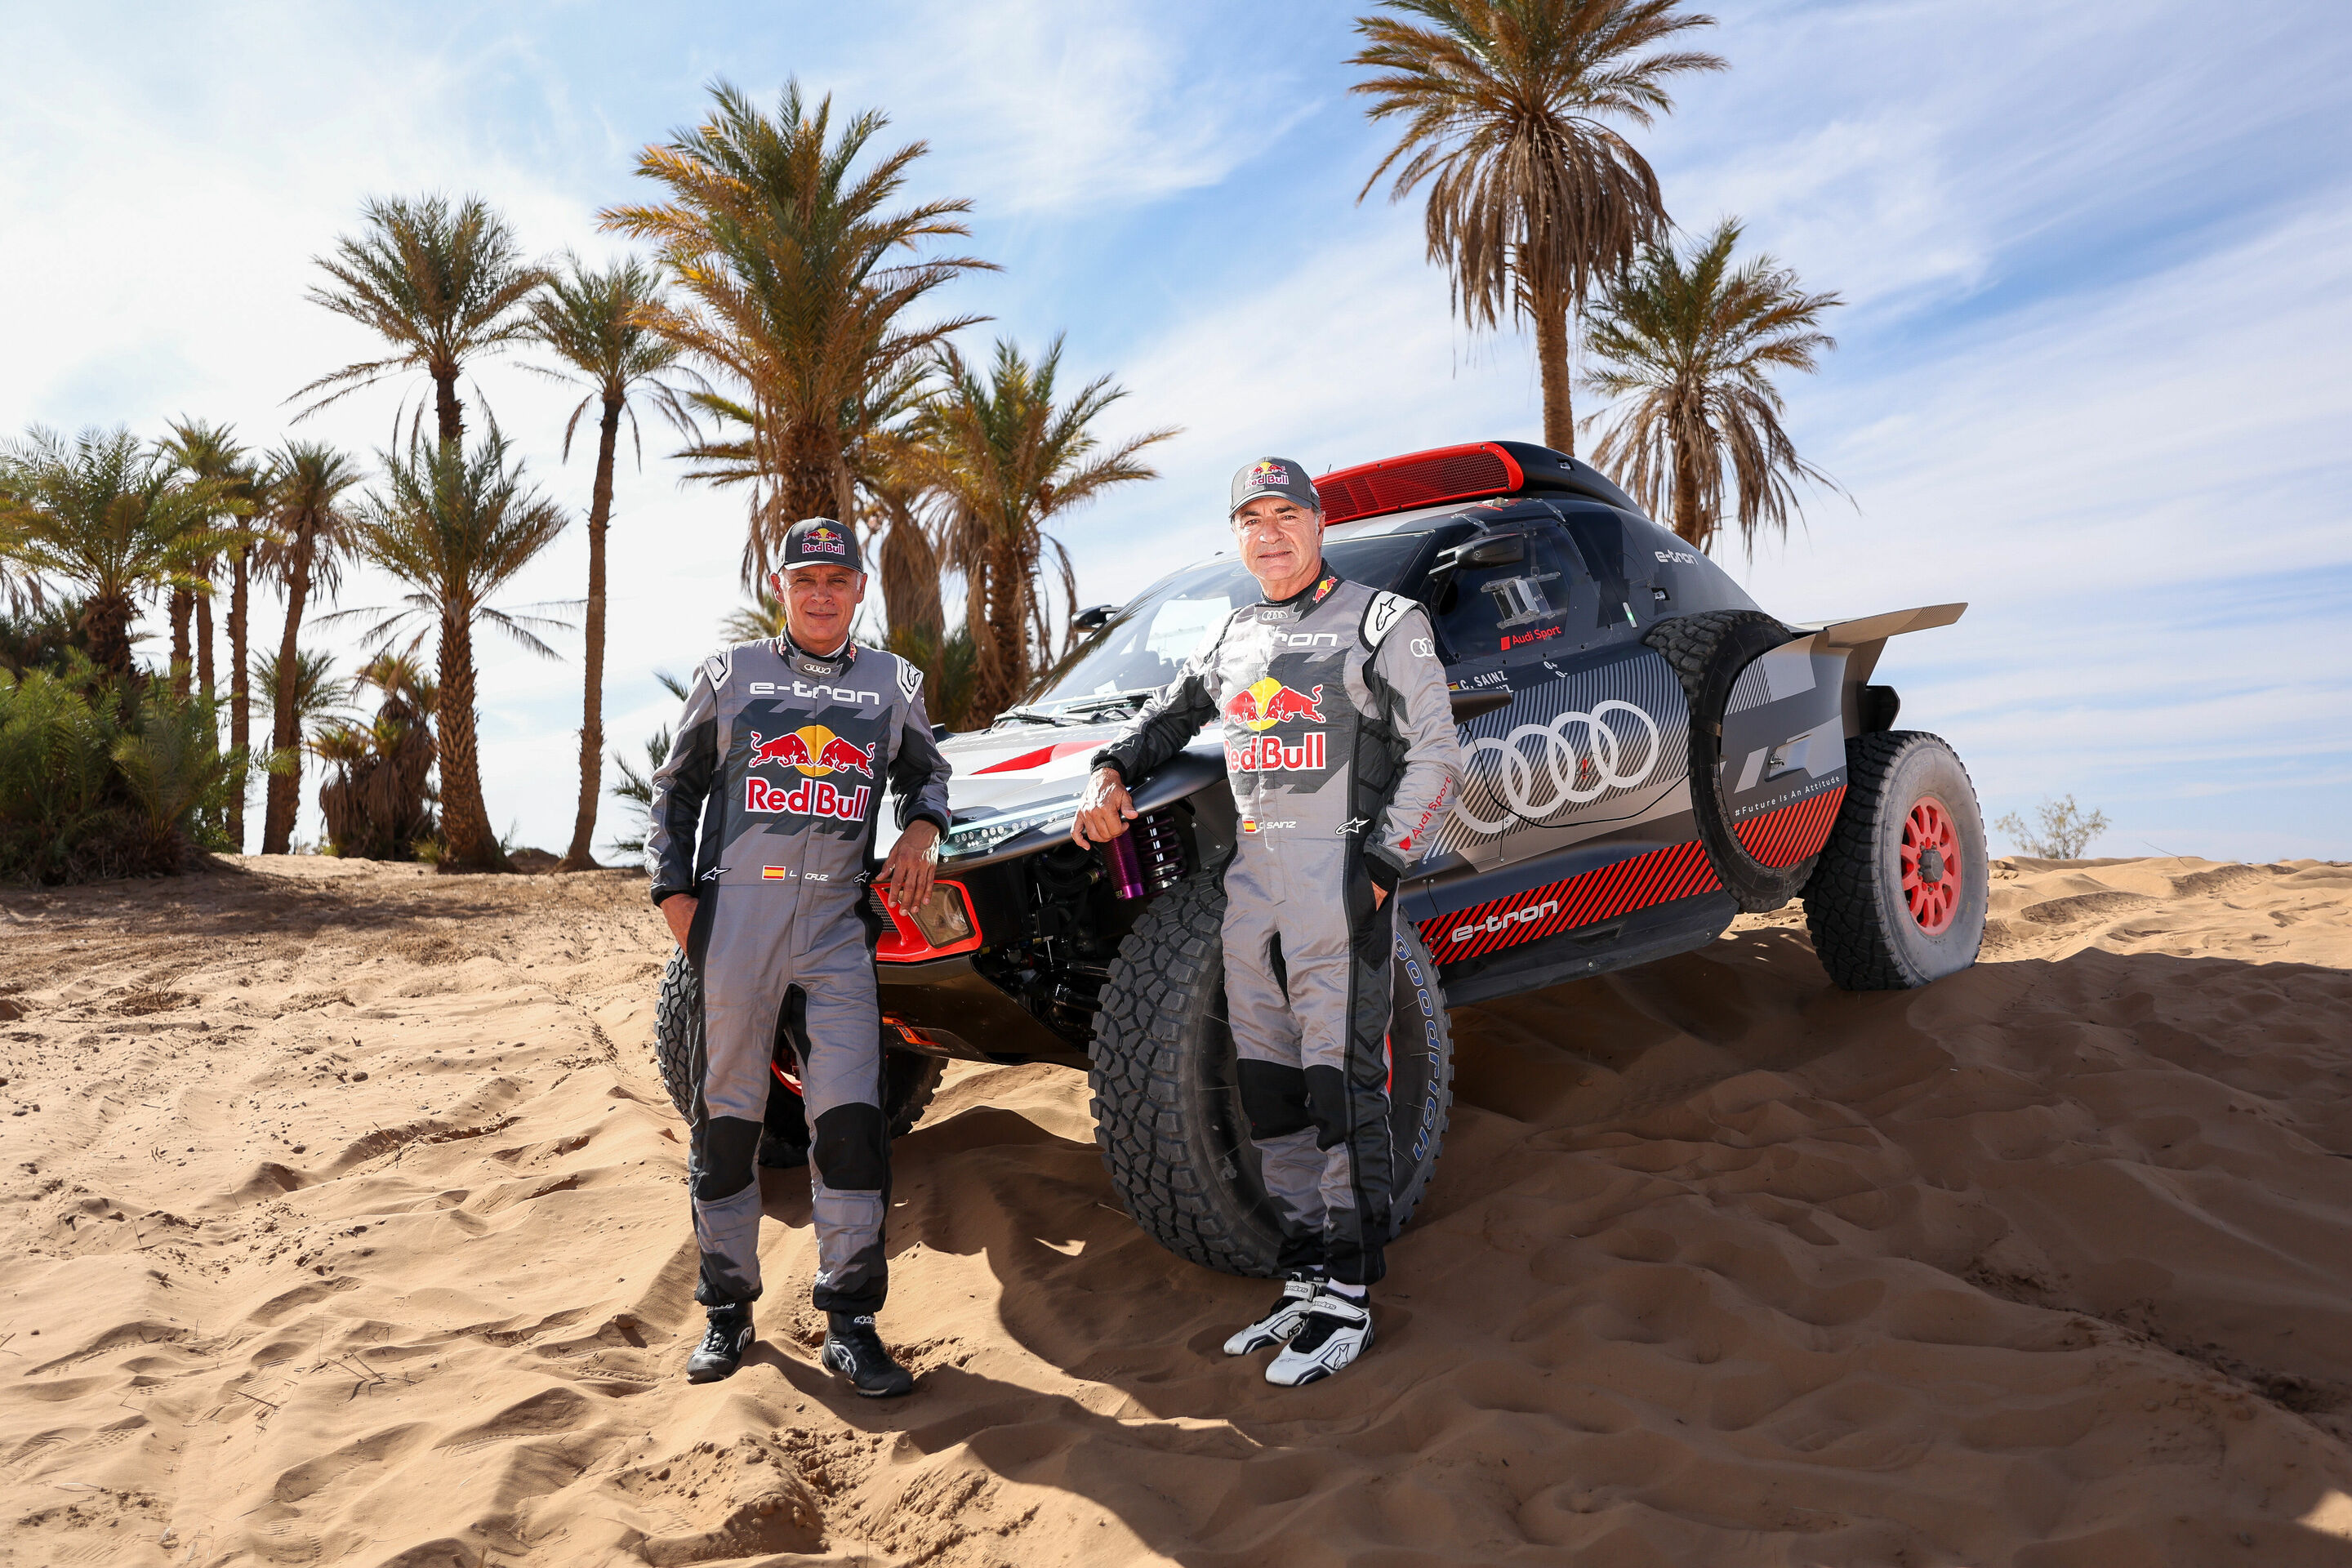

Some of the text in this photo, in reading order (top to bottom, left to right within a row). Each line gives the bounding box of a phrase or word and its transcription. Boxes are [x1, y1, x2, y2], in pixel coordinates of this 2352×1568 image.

[1245, 474, 1289, 490] Red Bull
[802, 541, 845, 555] Red Bull
[1655, 549, 1699, 565] e-tron
[1512, 626, 1561, 645] Audi Sport
[1473, 670, 1508, 688] SAINZ
[750, 680, 880, 706] e-tron
[1223, 732, 1326, 773] Red Bull
[745, 777, 871, 822] Red Bull
[1735, 775, 1840, 817] #Future Is An Attitude
[1412, 776, 1452, 840] Audi Sport
[1267, 821, 1297, 830] SAINZ
[804, 872, 829, 881] CRUZ
[1452, 900, 1558, 942] e-tron
